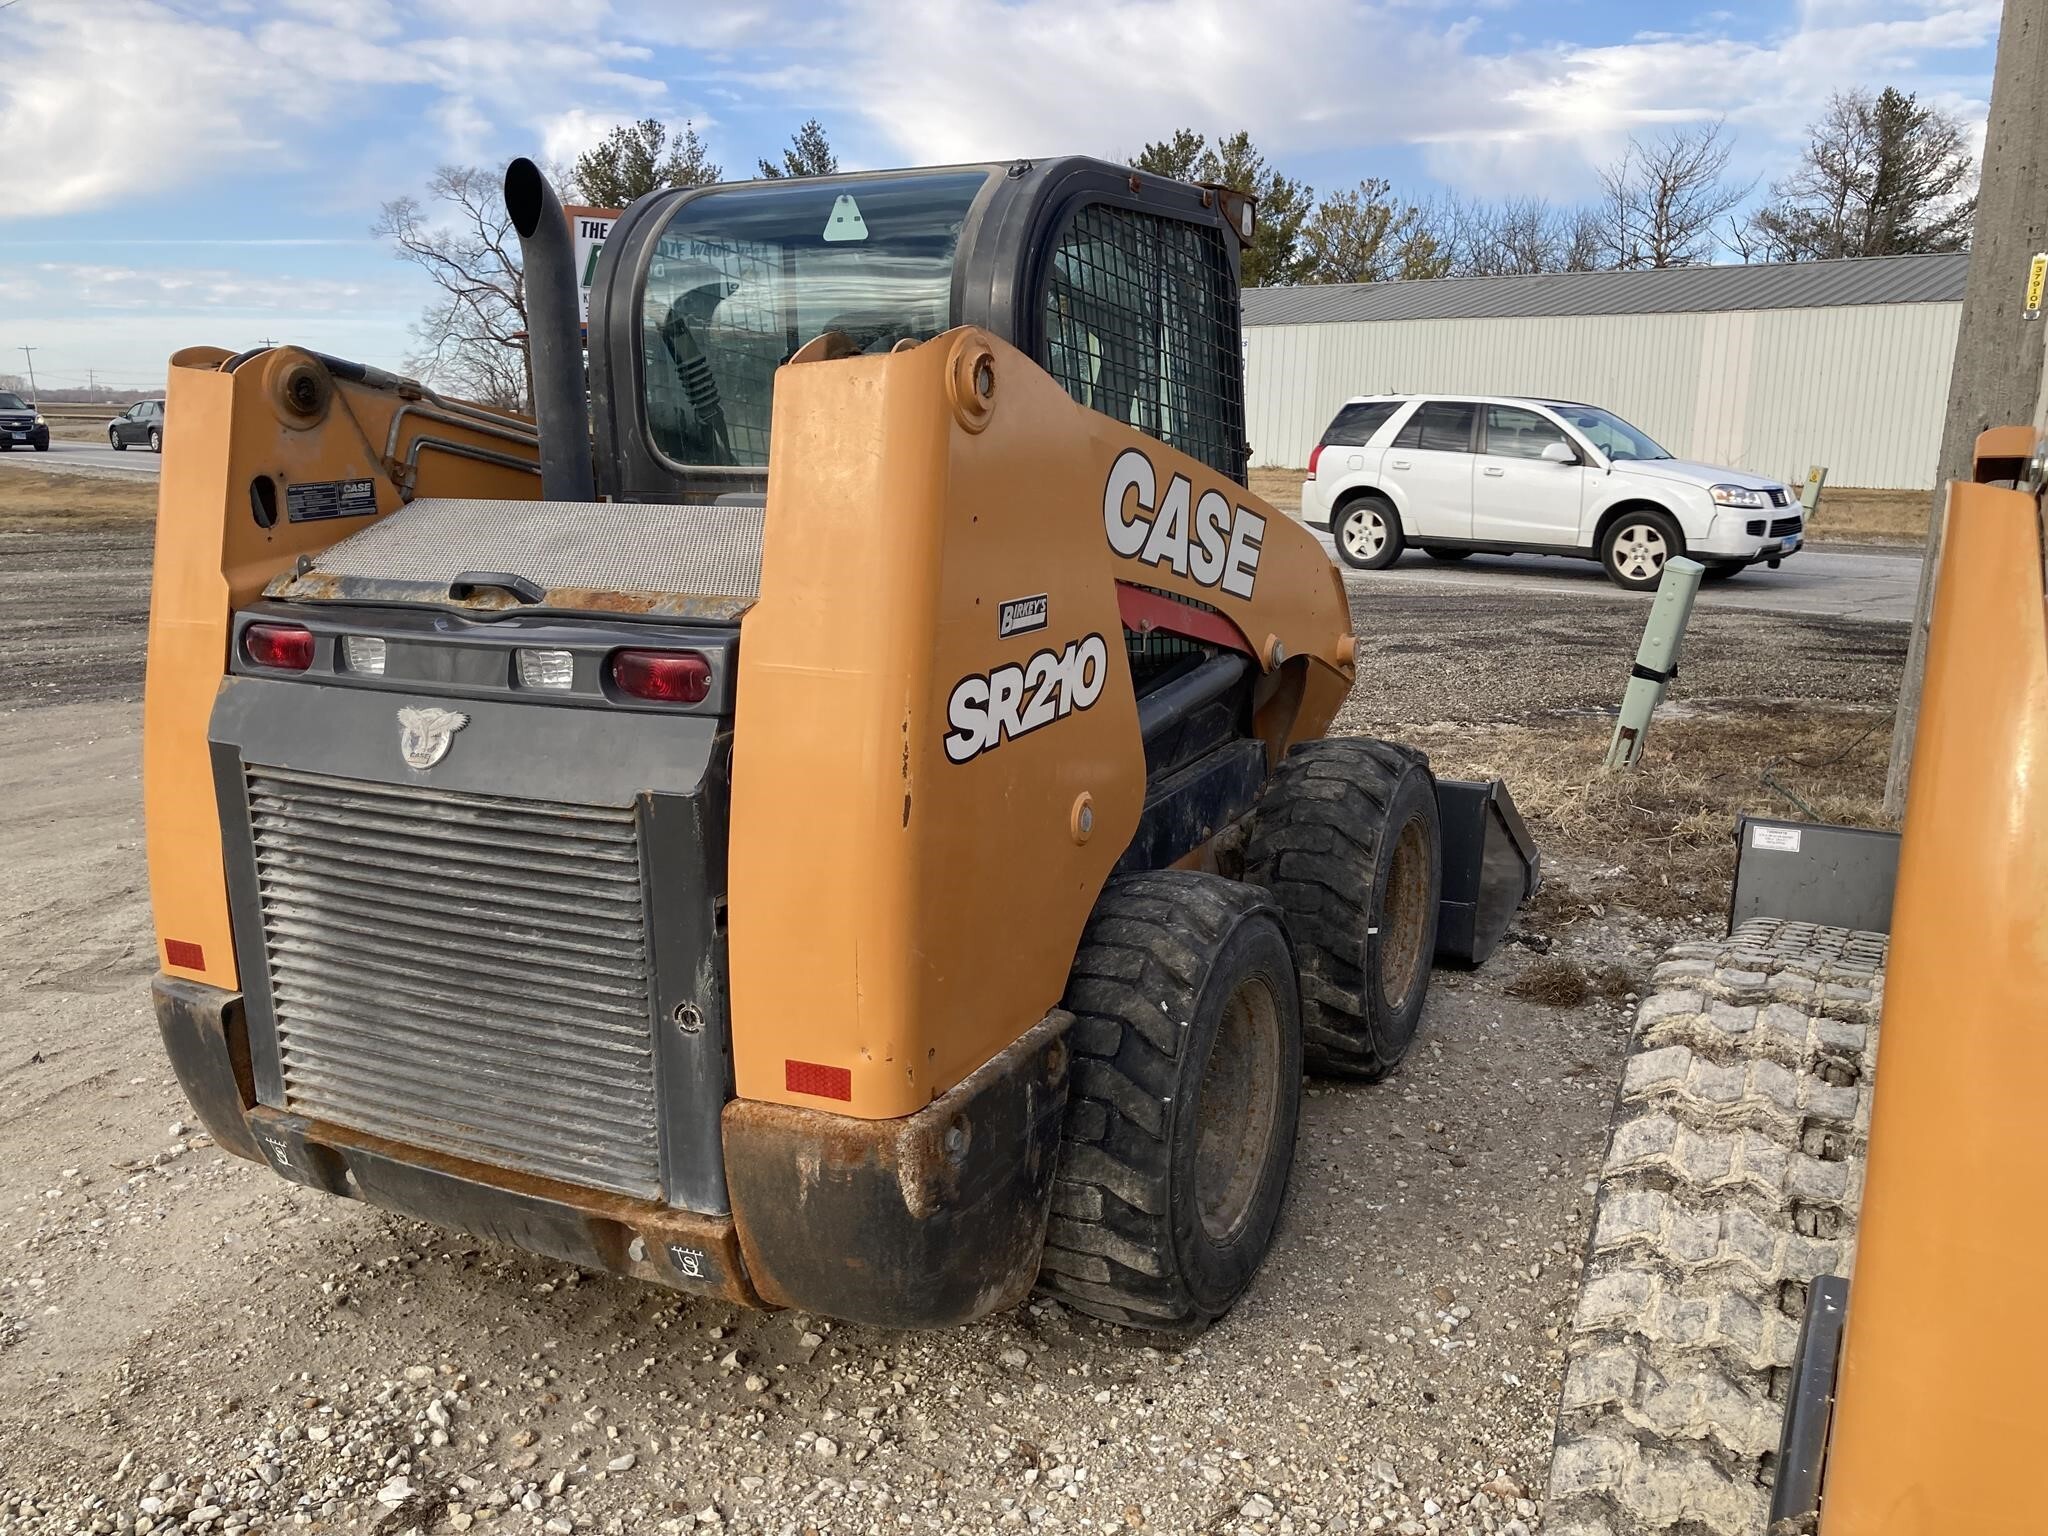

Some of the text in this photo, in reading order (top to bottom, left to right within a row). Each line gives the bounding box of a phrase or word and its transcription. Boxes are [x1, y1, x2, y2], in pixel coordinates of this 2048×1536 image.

[581, 221, 608, 239] THE
[2029, 266, 2042, 308] 379108
[344, 483, 371, 493] CASE
[1103, 447, 1267, 601] CASE
[1001, 598, 1047, 635] BIRKEY'S
[944, 632, 1107, 764] SR210
